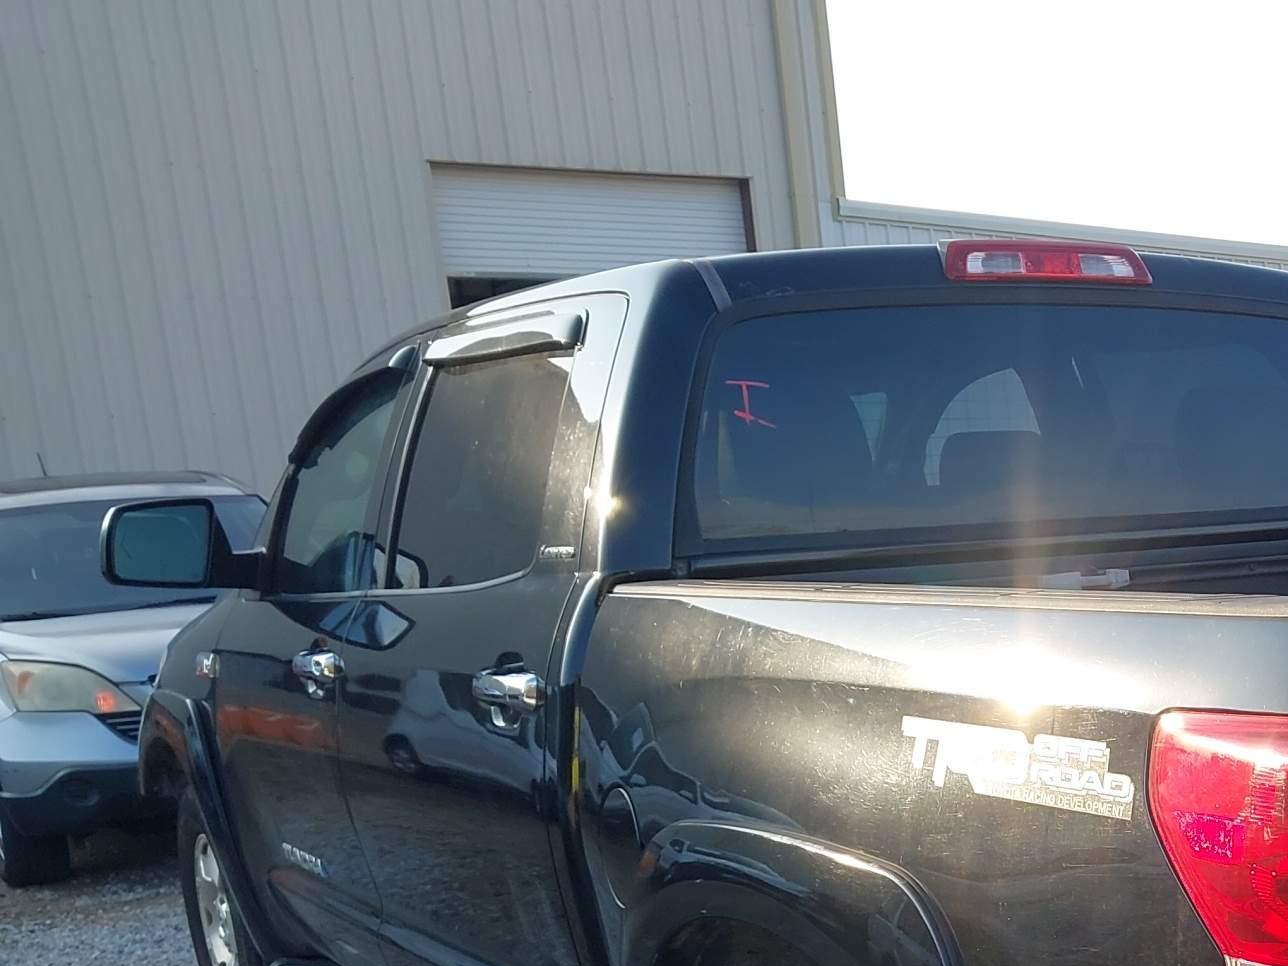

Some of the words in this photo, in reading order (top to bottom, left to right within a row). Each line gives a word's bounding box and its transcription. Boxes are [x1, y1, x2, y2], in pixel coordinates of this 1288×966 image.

[1034, 734, 1110, 771] OFF
[1032, 765, 1134, 801] ROAD
[1023, 789, 1056, 807] RACING
[1058, 796, 1125, 818] DEVELOPMENT
